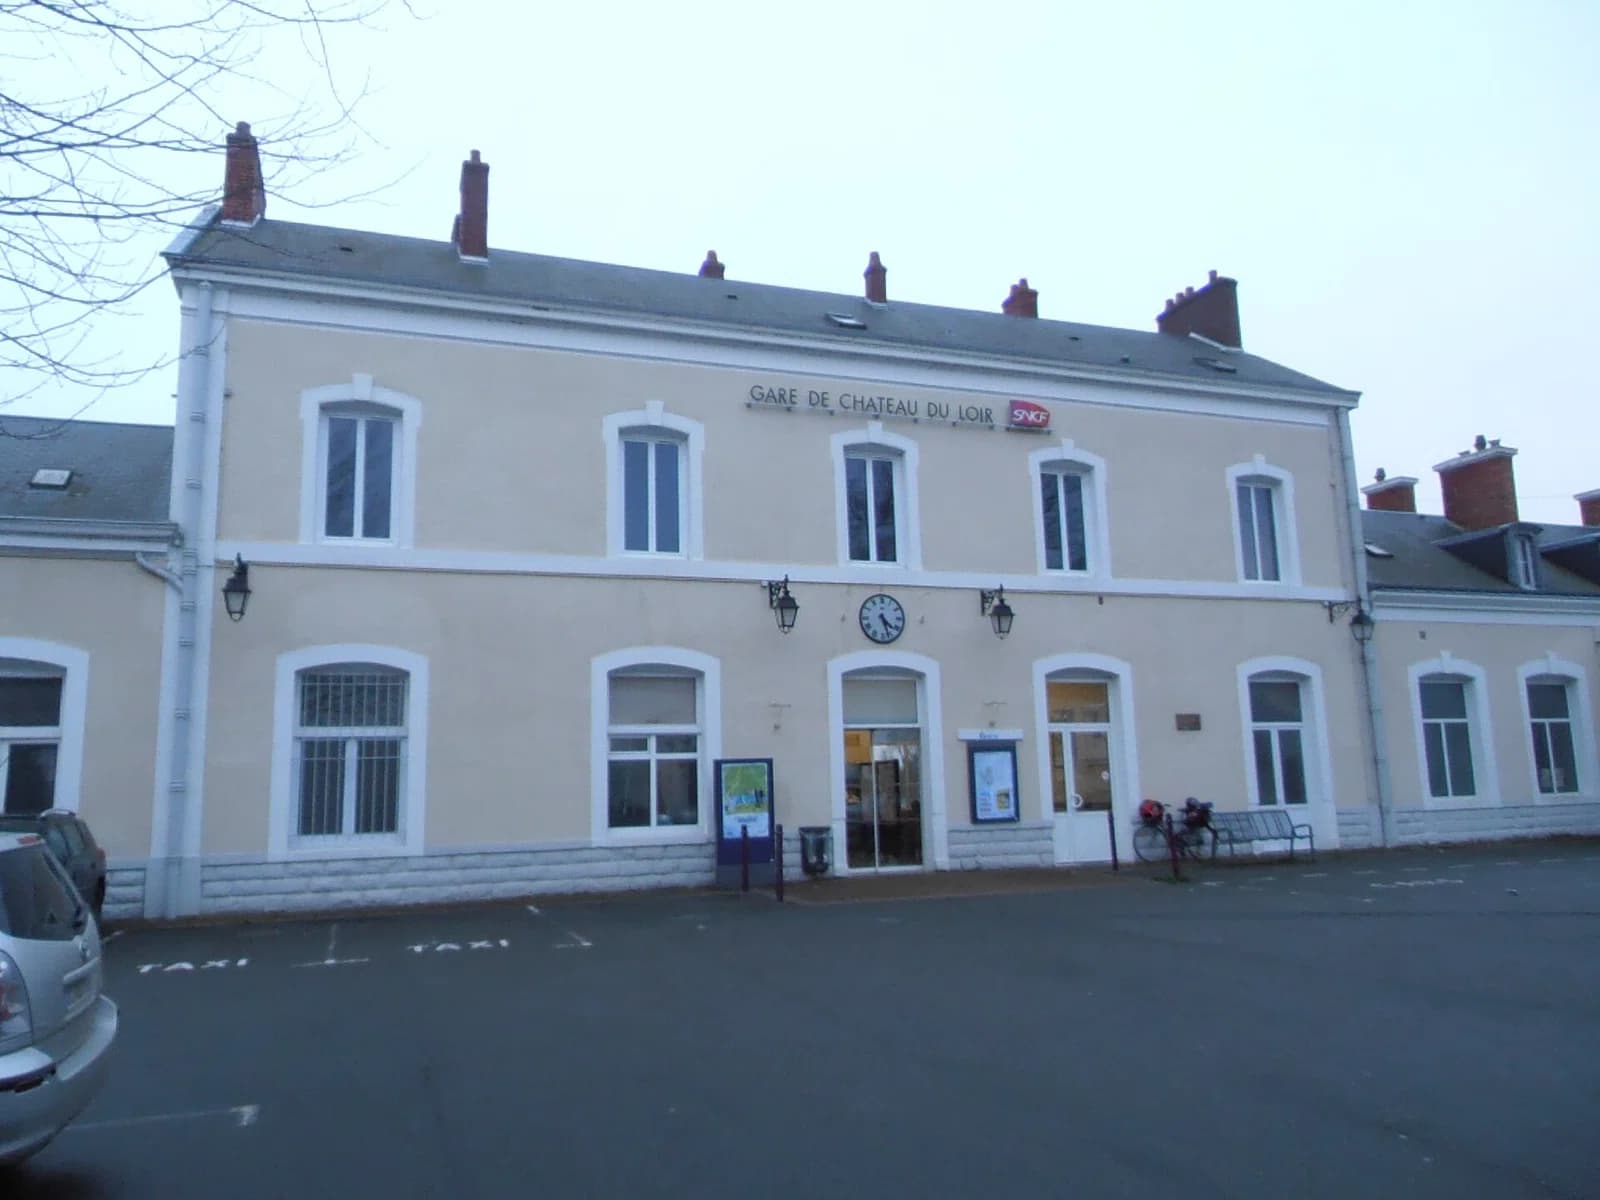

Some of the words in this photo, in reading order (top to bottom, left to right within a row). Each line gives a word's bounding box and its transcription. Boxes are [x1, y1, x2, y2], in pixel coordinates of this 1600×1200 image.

[750, 385, 798, 405] GARE
[809, 390, 830, 408] DE
[840, 393, 917, 416] CHATEAU
[928, 401, 949, 418] DU
[959, 404, 994, 423] LOIR
[1012, 409, 1049, 424] SNCF
[406, 938, 510, 953] TAXI
[136, 957, 249, 974] TAXI
